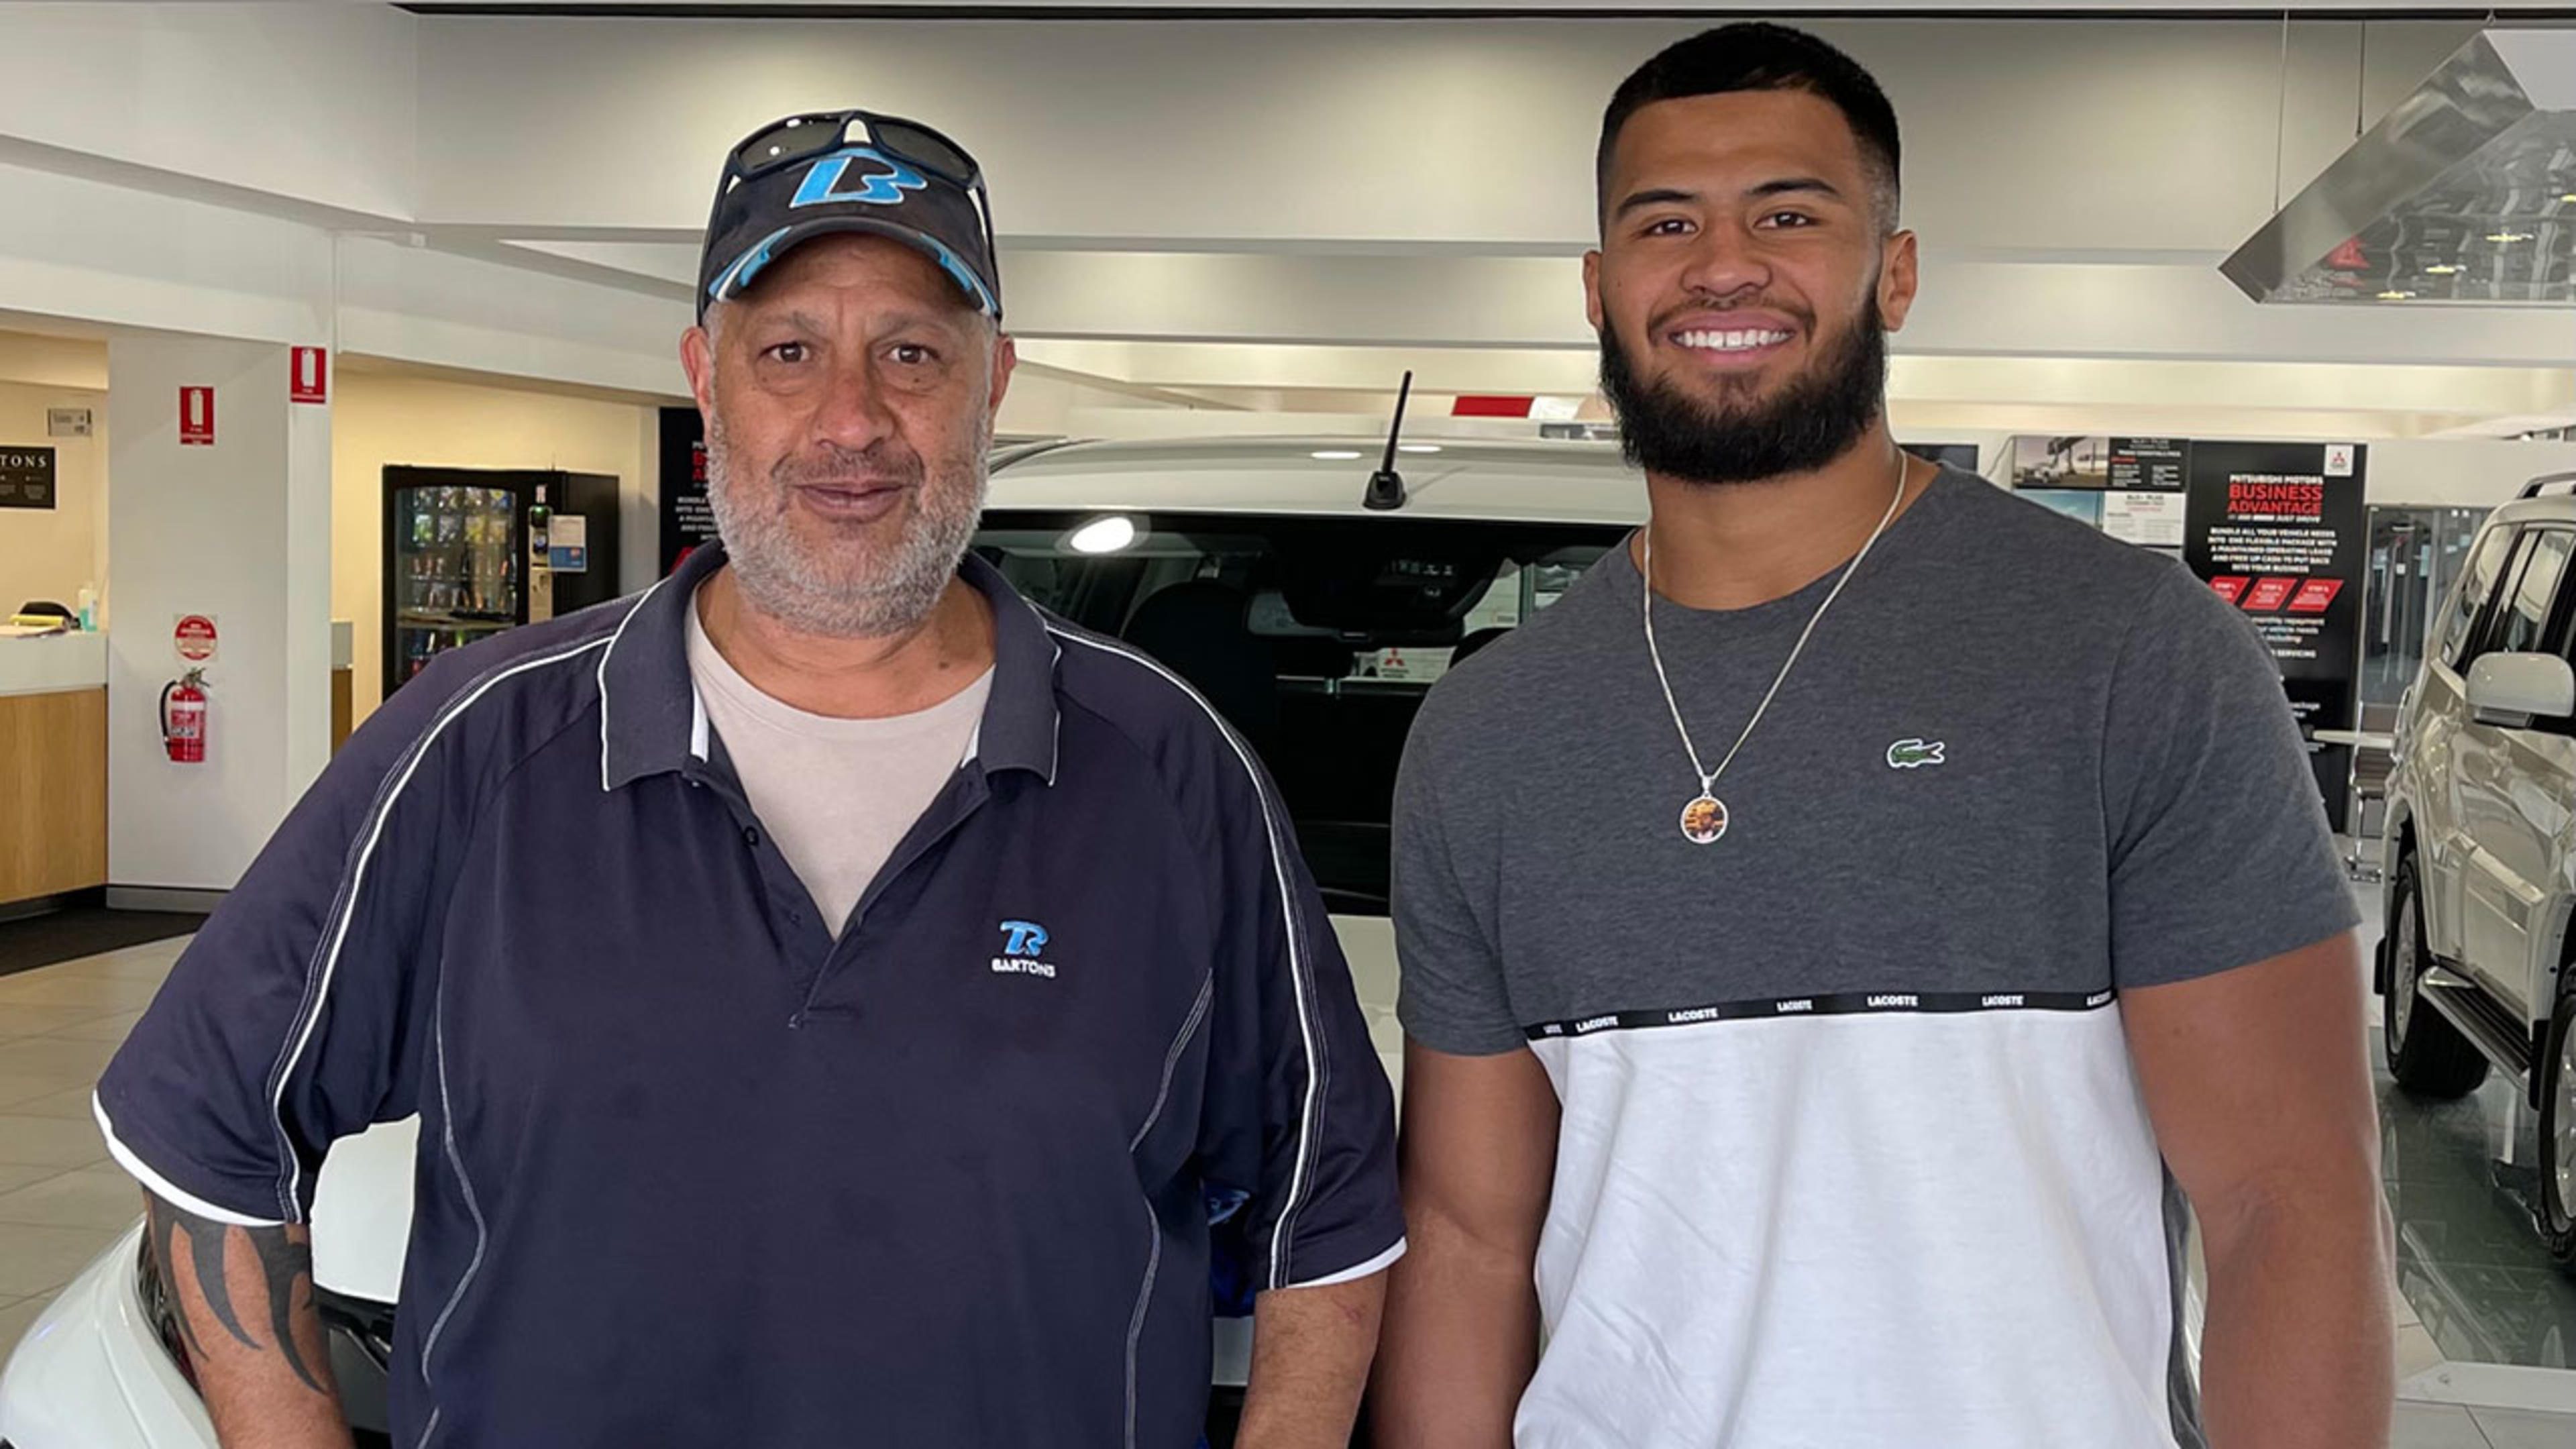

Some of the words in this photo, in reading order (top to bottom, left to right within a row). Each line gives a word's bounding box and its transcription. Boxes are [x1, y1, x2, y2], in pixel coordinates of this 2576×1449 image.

[2284, 475, 2323, 484] MOTORS
[2229, 484, 2323, 500] BUSINESS
[2228, 500, 2322, 515] ADVANTAGE
[1575, 1016, 1619, 1032] LACOSTE
[1668, 1008, 1718, 1023] LACOSTE
[1776, 1000, 1813, 1012] LACOSTE
[1867, 996, 1919, 1007] LACOSTE
[1982, 995, 2024, 1007] LACOSTE
